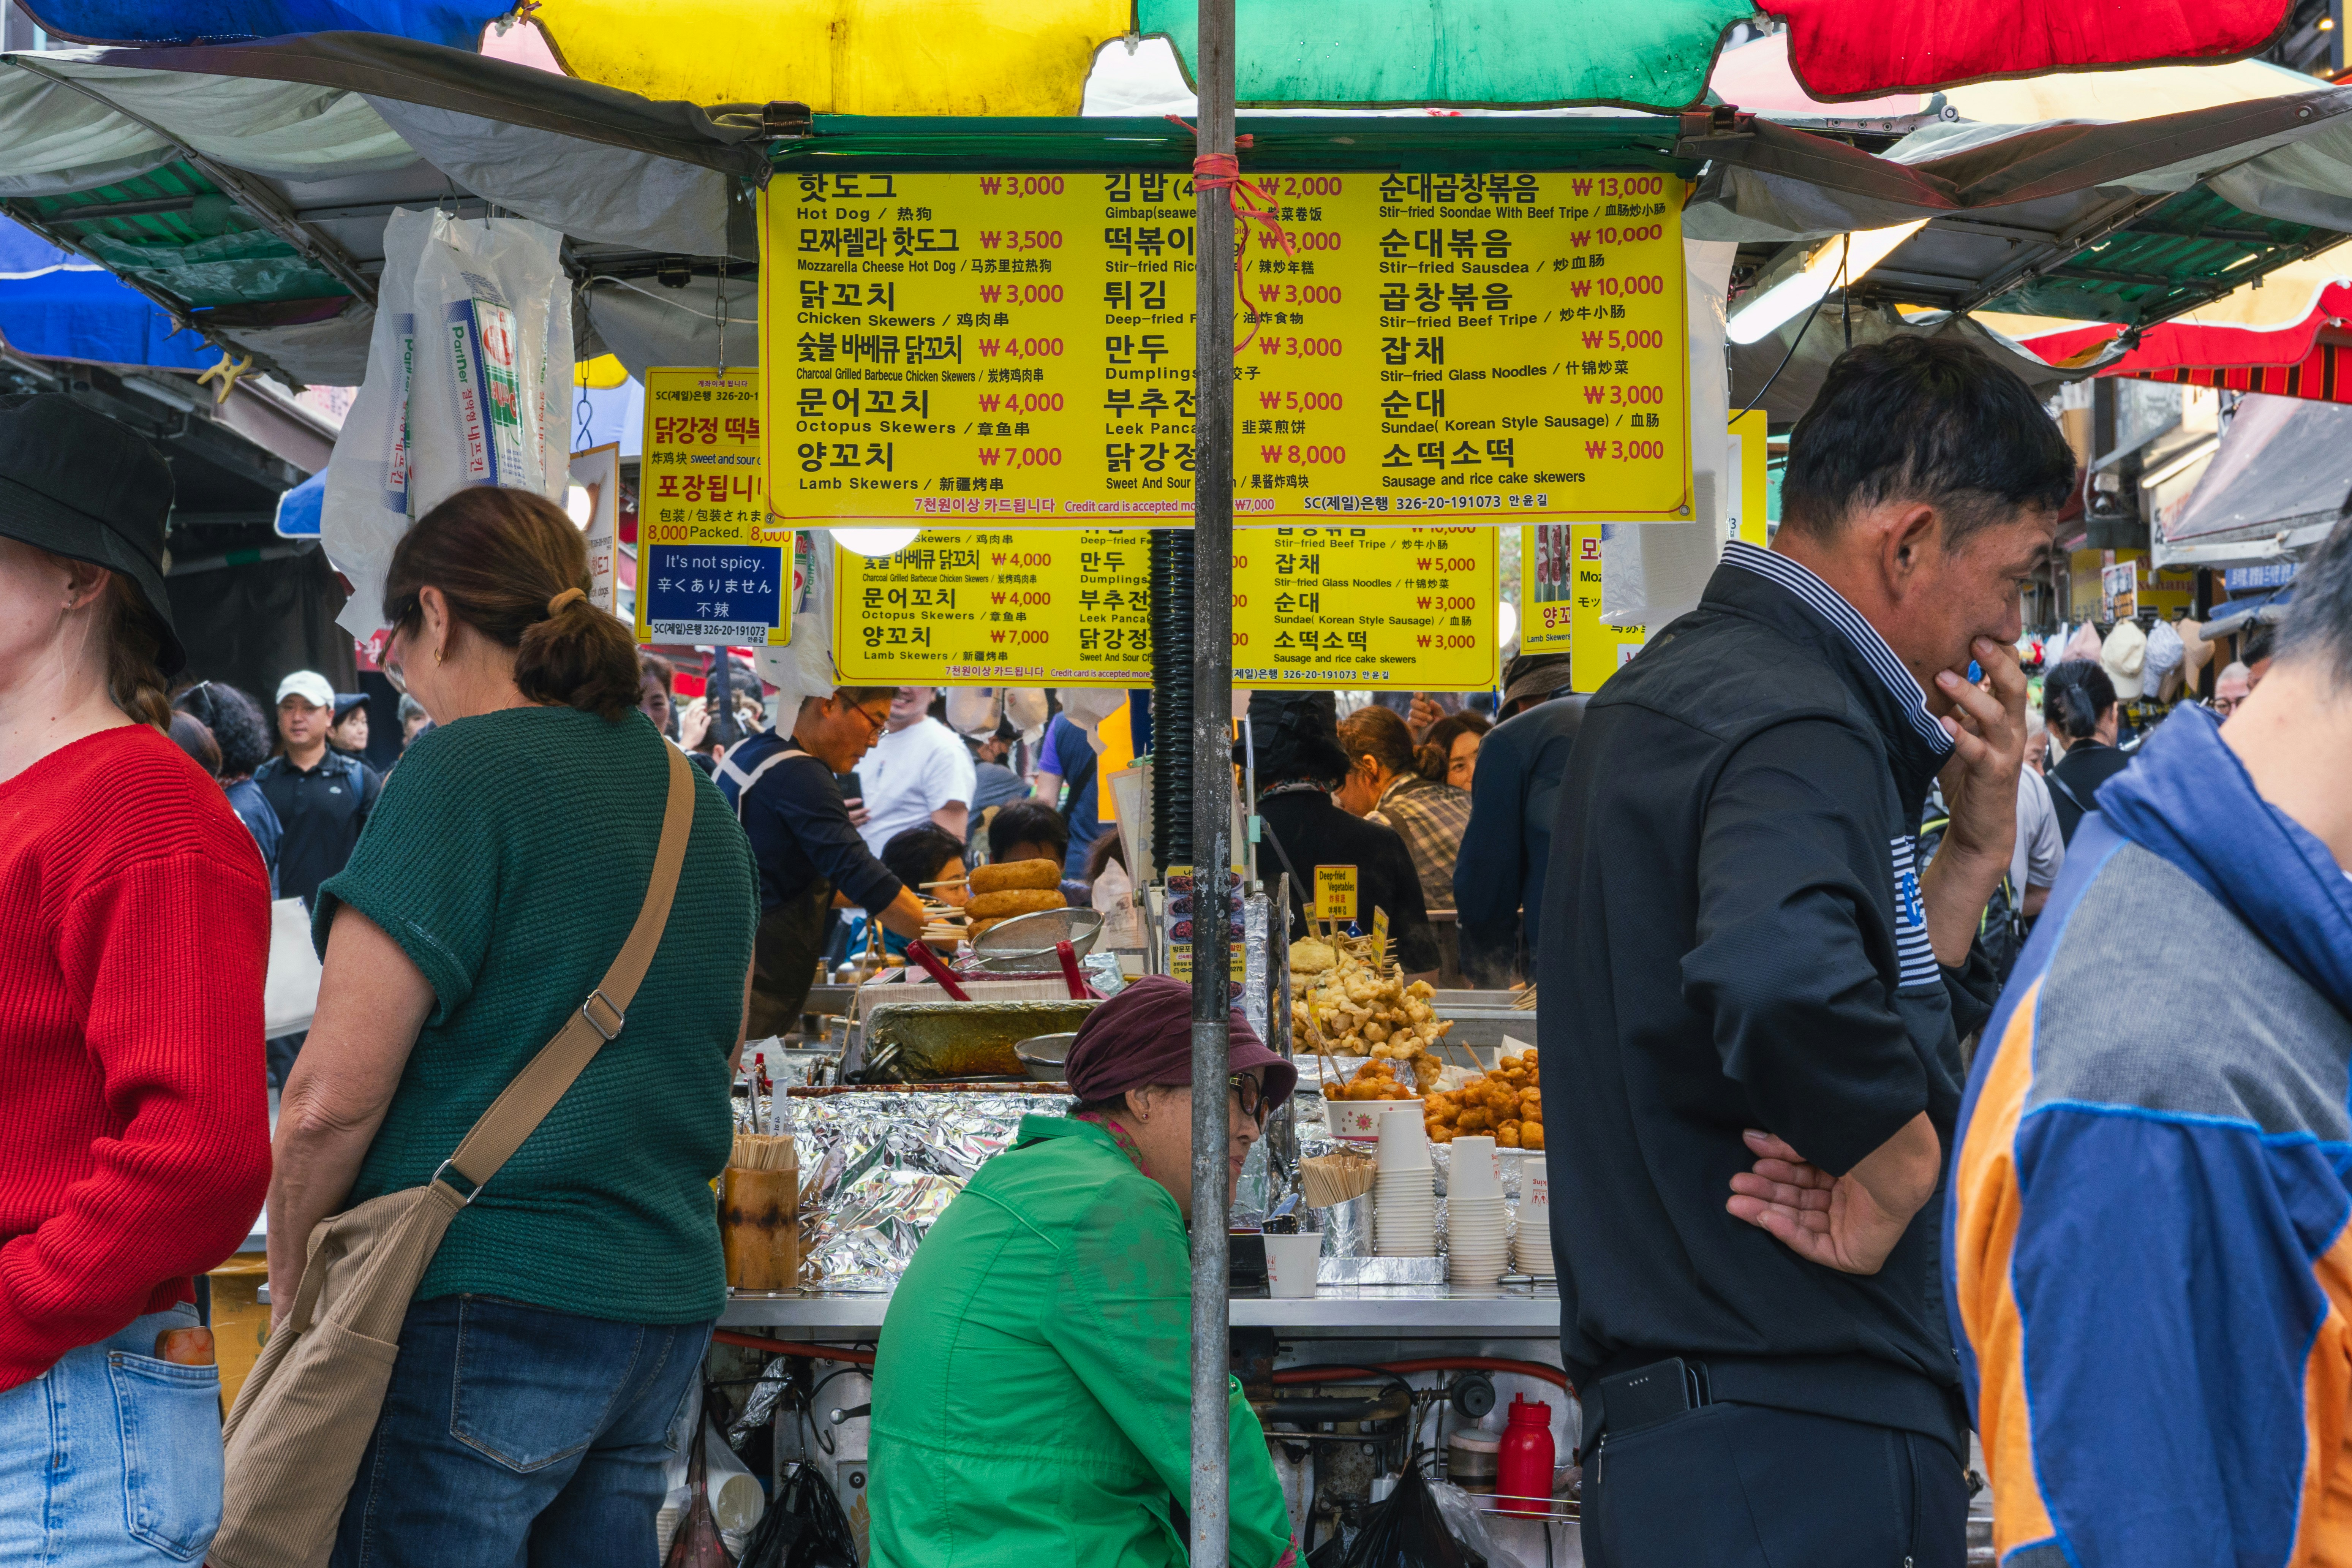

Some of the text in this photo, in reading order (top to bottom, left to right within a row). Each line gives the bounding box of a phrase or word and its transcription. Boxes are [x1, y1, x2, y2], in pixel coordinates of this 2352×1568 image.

[797, 175, 897, 203] 핫도그
[1379, 173, 1540, 204] 순대곱창볶음
[797, 207, 931, 222] Hot Dog 热狗
[1379, 202, 1666, 221] Stir-fried Soondae With Beef Tripe 血肠炒小肠
[797, 227, 959, 258] 모짜렐라 핫도그
[1105, 226, 1193, 256] 떡볶이
[1379, 228, 1512, 259] 순대볶음
[798, 258, 1051, 275] Mozzarella Cheese Hot Dog 马苏里拉热狗
[1106, 260, 1168, 272] Stir-fried
[1379, 253, 1604, 273] Stir-fried Sausdea 炒血肠
[800, 280, 894, 312] 닭꼬치
[1103, 280, 1165, 310] 튀김
[1379, 282, 1513, 313] 곱창볶음
[797, 311, 1009, 327] Chicken Skewers 鸡肉串
[1106, 313, 1183, 327] Deep-fried
[1380, 304, 1625, 328] Stir-fried Beef Tripe 炒牛小肠
[797, 332, 961, 365] 숯불 바베큐 닭꼬치
[1106, 335, 1169, 364] 만두
[1381, 336, 1444, 365] 잡채
[797, 367, 1043, 383] Charcoal Grilled Barbecue Chicken Skewers 炭烤鸡肉串
[1380, 360, 1628, 382] Stir-fried Glass Noodles 什锦炒菜
[452, 326, 484, 473] Partner 절약형 내프킨
[656, 390, 711, 401] SC(제일)은행
[796, 387, 928, 419] 문어꼬치
[1381, 389, 1445, 418] 순대
[655, 416, 718, 444] 닭강정
[796, 420, 1030, 436] Octopus Skewers 章鱼串
[1106, 422, 1143, 435] Leek
[1242, 419, 1306, 434] 韭菜煎饼
[1381, 413, 1659, 433] Sundae( Korean Style Sausage) 血肠
[651, 451, 756, 465] 炸鸡块 sweet and sour
[797, 442, 893, 472] 양꼬치
[1381, 438, 1514, 470] 소떡소떡
[657, 474, 761, 503] 포장됩니
[800, 477, 1004, 492] Lamb Skewers 新疆烤串
[1106, 476, 1191, 489] Sweet And Sour
[1251, 474, 1309, 489] 果酱炸鸡块
[1382, 471, 1585, 489] Sausage and rice cake skewers
[915, 498, 1055, 513] 7천원이상 카드됩니다
[1065, 500, 1179, 514] Credit card is accepted
[1304, 496, 1389, 511] SC(제일)은행
[1397, 496, 1501, 510] 326-20-191073
[659, 508, 685, 523] 包装
[648, 525, 688, 542] 8,000
[690, 526, 743, 538] Packed.
[666, 555, 765, 572] It's not spicy.
[658, 577, 772, 594] 辛くありません
[862, 573, 1037, 584] Charcoal Grilled Barbecue Chicken Skewers 炭烤鸡肉串
[697, 602, 729, 618] 不辣
[862, 610, 1026, 622] Octopus Skewers 章鱼串
[654, 623, 765, 637] SC(제일)은행 326-20-191073
[1080, 628, 1147, 650] 닭강정
[1080, 653, 1140, 662] Sweet And Sour
[1274, 654, 1416, 664] Sausage and rice cake skewers
[945, 666, 1044, 677] 7천원이상 카드됩니다
[1283, 670, 1356, 679] 326-20-191073
[1320, 871, 1346, 880] Deep-fried
[1328, 882, 1355, 891] Vegetables
